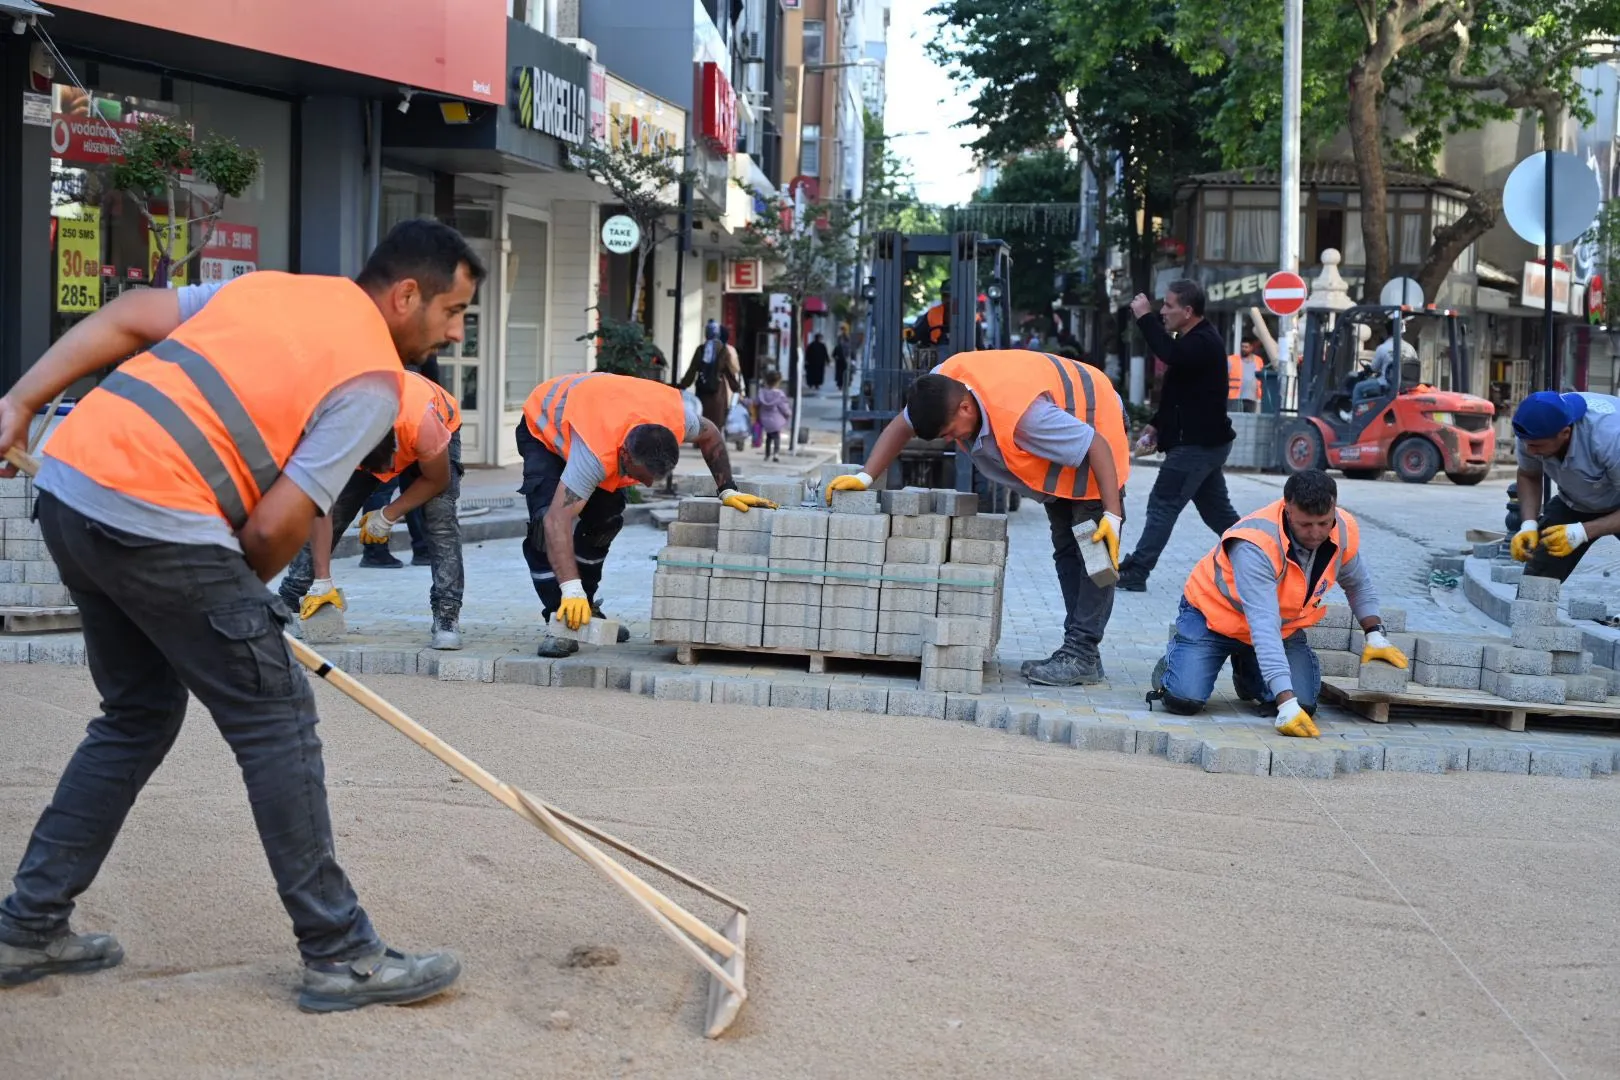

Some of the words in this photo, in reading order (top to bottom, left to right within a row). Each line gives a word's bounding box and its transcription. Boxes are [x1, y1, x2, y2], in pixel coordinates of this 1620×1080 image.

[533, 66, 585, 145] BARGELLO
[71, 121, 117, 139] vodafone
[62, 228, 77, 238] 250
[78, 229, 95, 240] SMS
[609, 228, 631, 237] TAKE
[608, 239, 632, 247] AWAY
[62, 249, 82, 277] 30
[84, 259, 98, 277] GB
[735, 263, 752, 285] E
[61, 284, 87, 307] 285
[88, 295, 97, 307] TL
